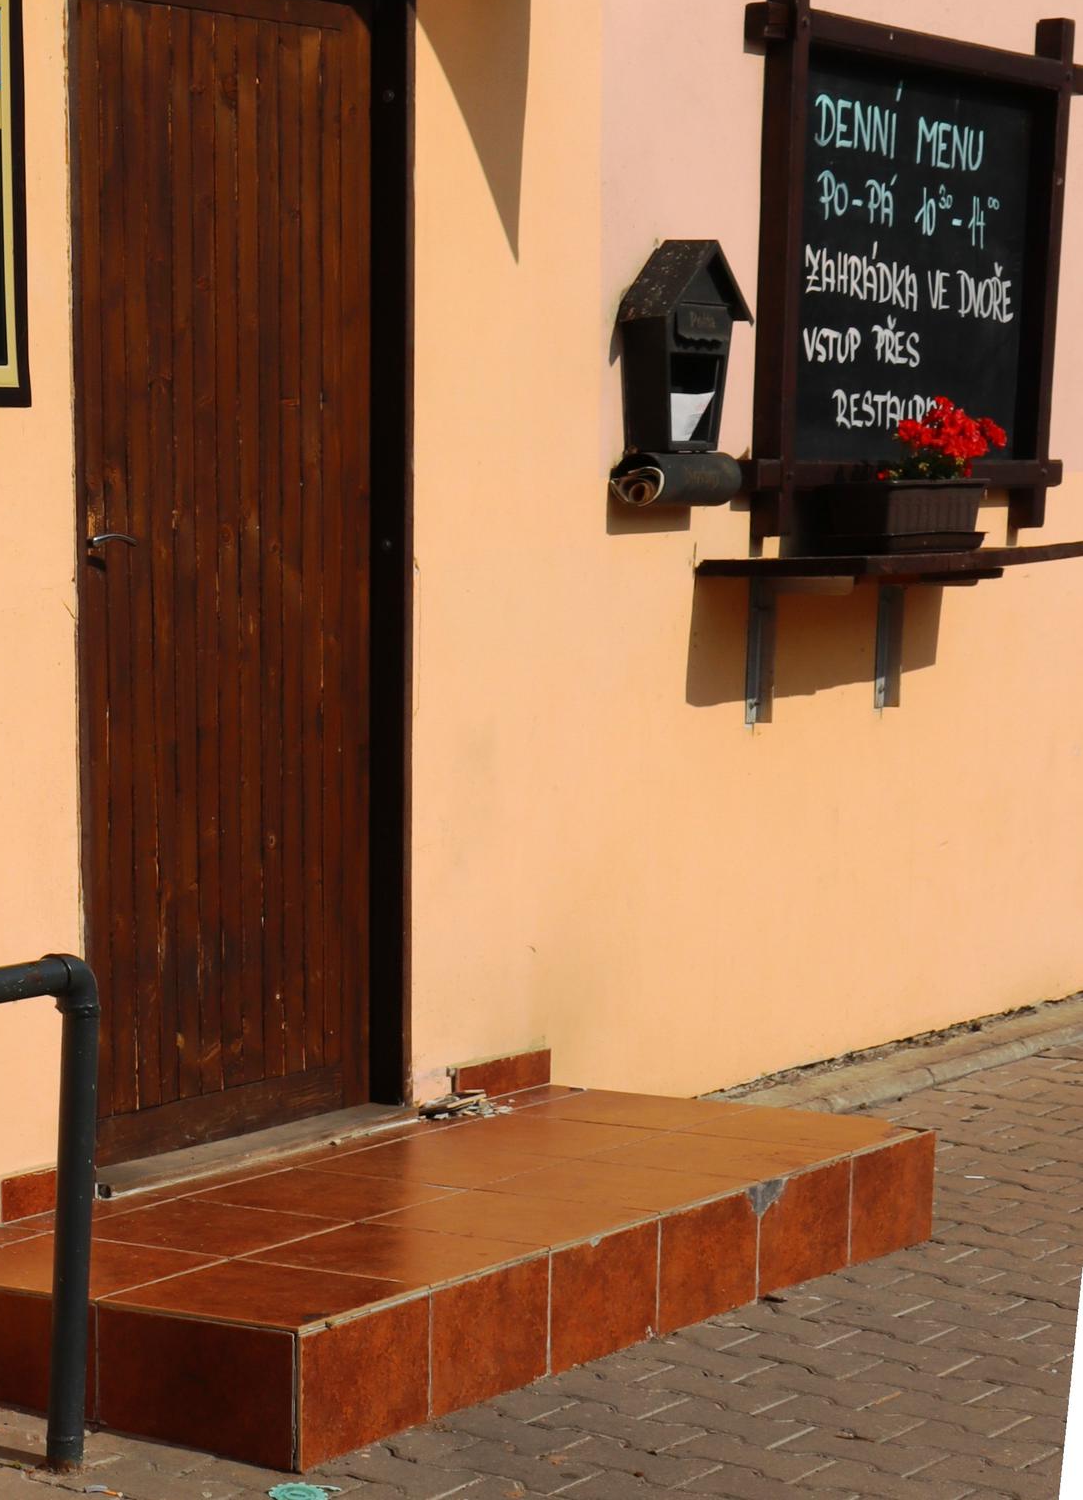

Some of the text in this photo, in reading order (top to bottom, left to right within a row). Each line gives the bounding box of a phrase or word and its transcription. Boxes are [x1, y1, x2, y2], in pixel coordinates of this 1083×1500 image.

[814, 82, 984, 172] DENNÍ MENU
[805, 241, 1014, 324] ZAHRÁDKA VE DVOŘE
[803, 314, 921, 368] VSTUP PŘES
